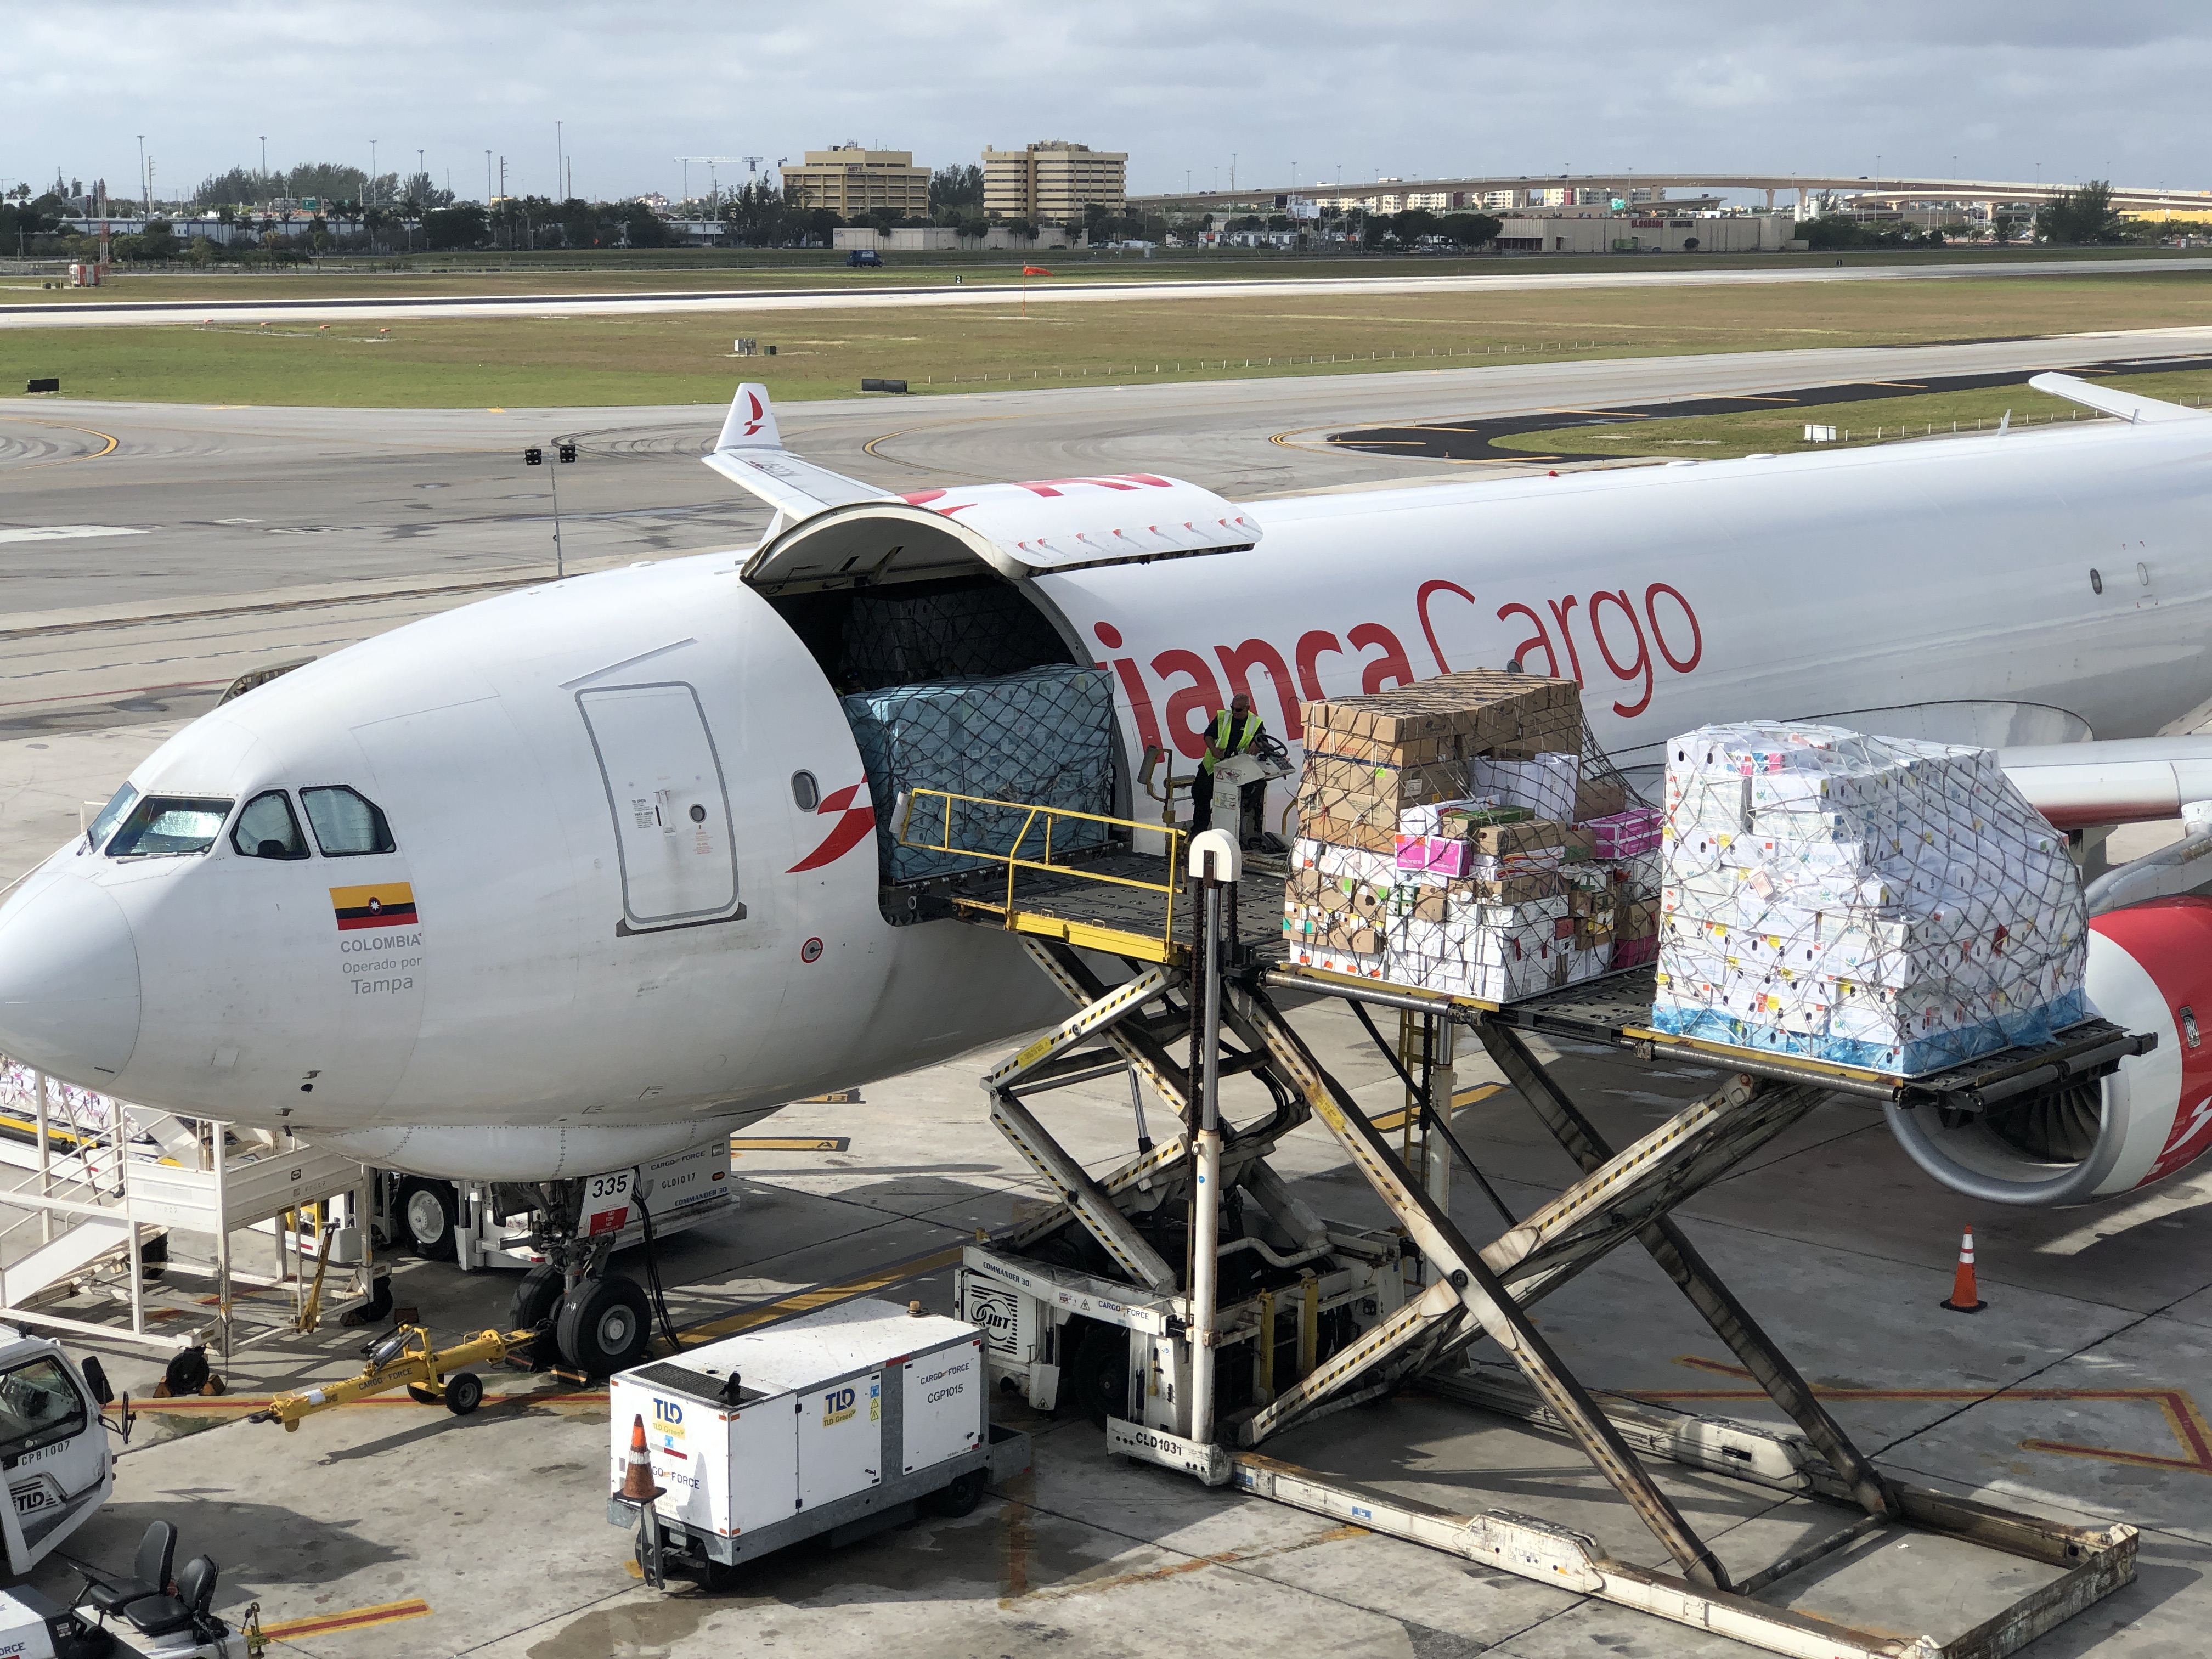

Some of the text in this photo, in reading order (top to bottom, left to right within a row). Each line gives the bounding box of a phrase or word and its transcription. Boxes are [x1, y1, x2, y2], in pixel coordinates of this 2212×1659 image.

[341, 934, 421, 952] COLOMBIA
[342, 957, 422, 974] Operado por
[351, 977, 413, 994] Tampa
[651, 1151, 705, 1170] CARGO FORCE
[592, 1175, 628, 1198] 335
[675, 1189, 716, 1206] COMMANDER
[983, 1262, 1020, 1283] COMMANDER
[1098, 1300, 1150, 1320] CARGO FORCE
[986, 1313, 1011, 1329] JBT
[359, 1368, 413, 1390] CARGO FORCE
[921, 1363, 969, 1385] CARGO FORCE
[826, 1388, 855, 1414] TLD
[927, 1384, 963, 1403] CGP1015
[653, 1398, 682, 1424] TLD
[823, 1413, 853, 1426] TLD Green
[664, 1426, 680, 1436] Green
[22, 1440, 70, 1466] CPB1007
[672, 1472, 700, 1489] FORCE
[17, 1492, 44, 1511] TLD
[0, 1642, 26, 1656] ORCE
